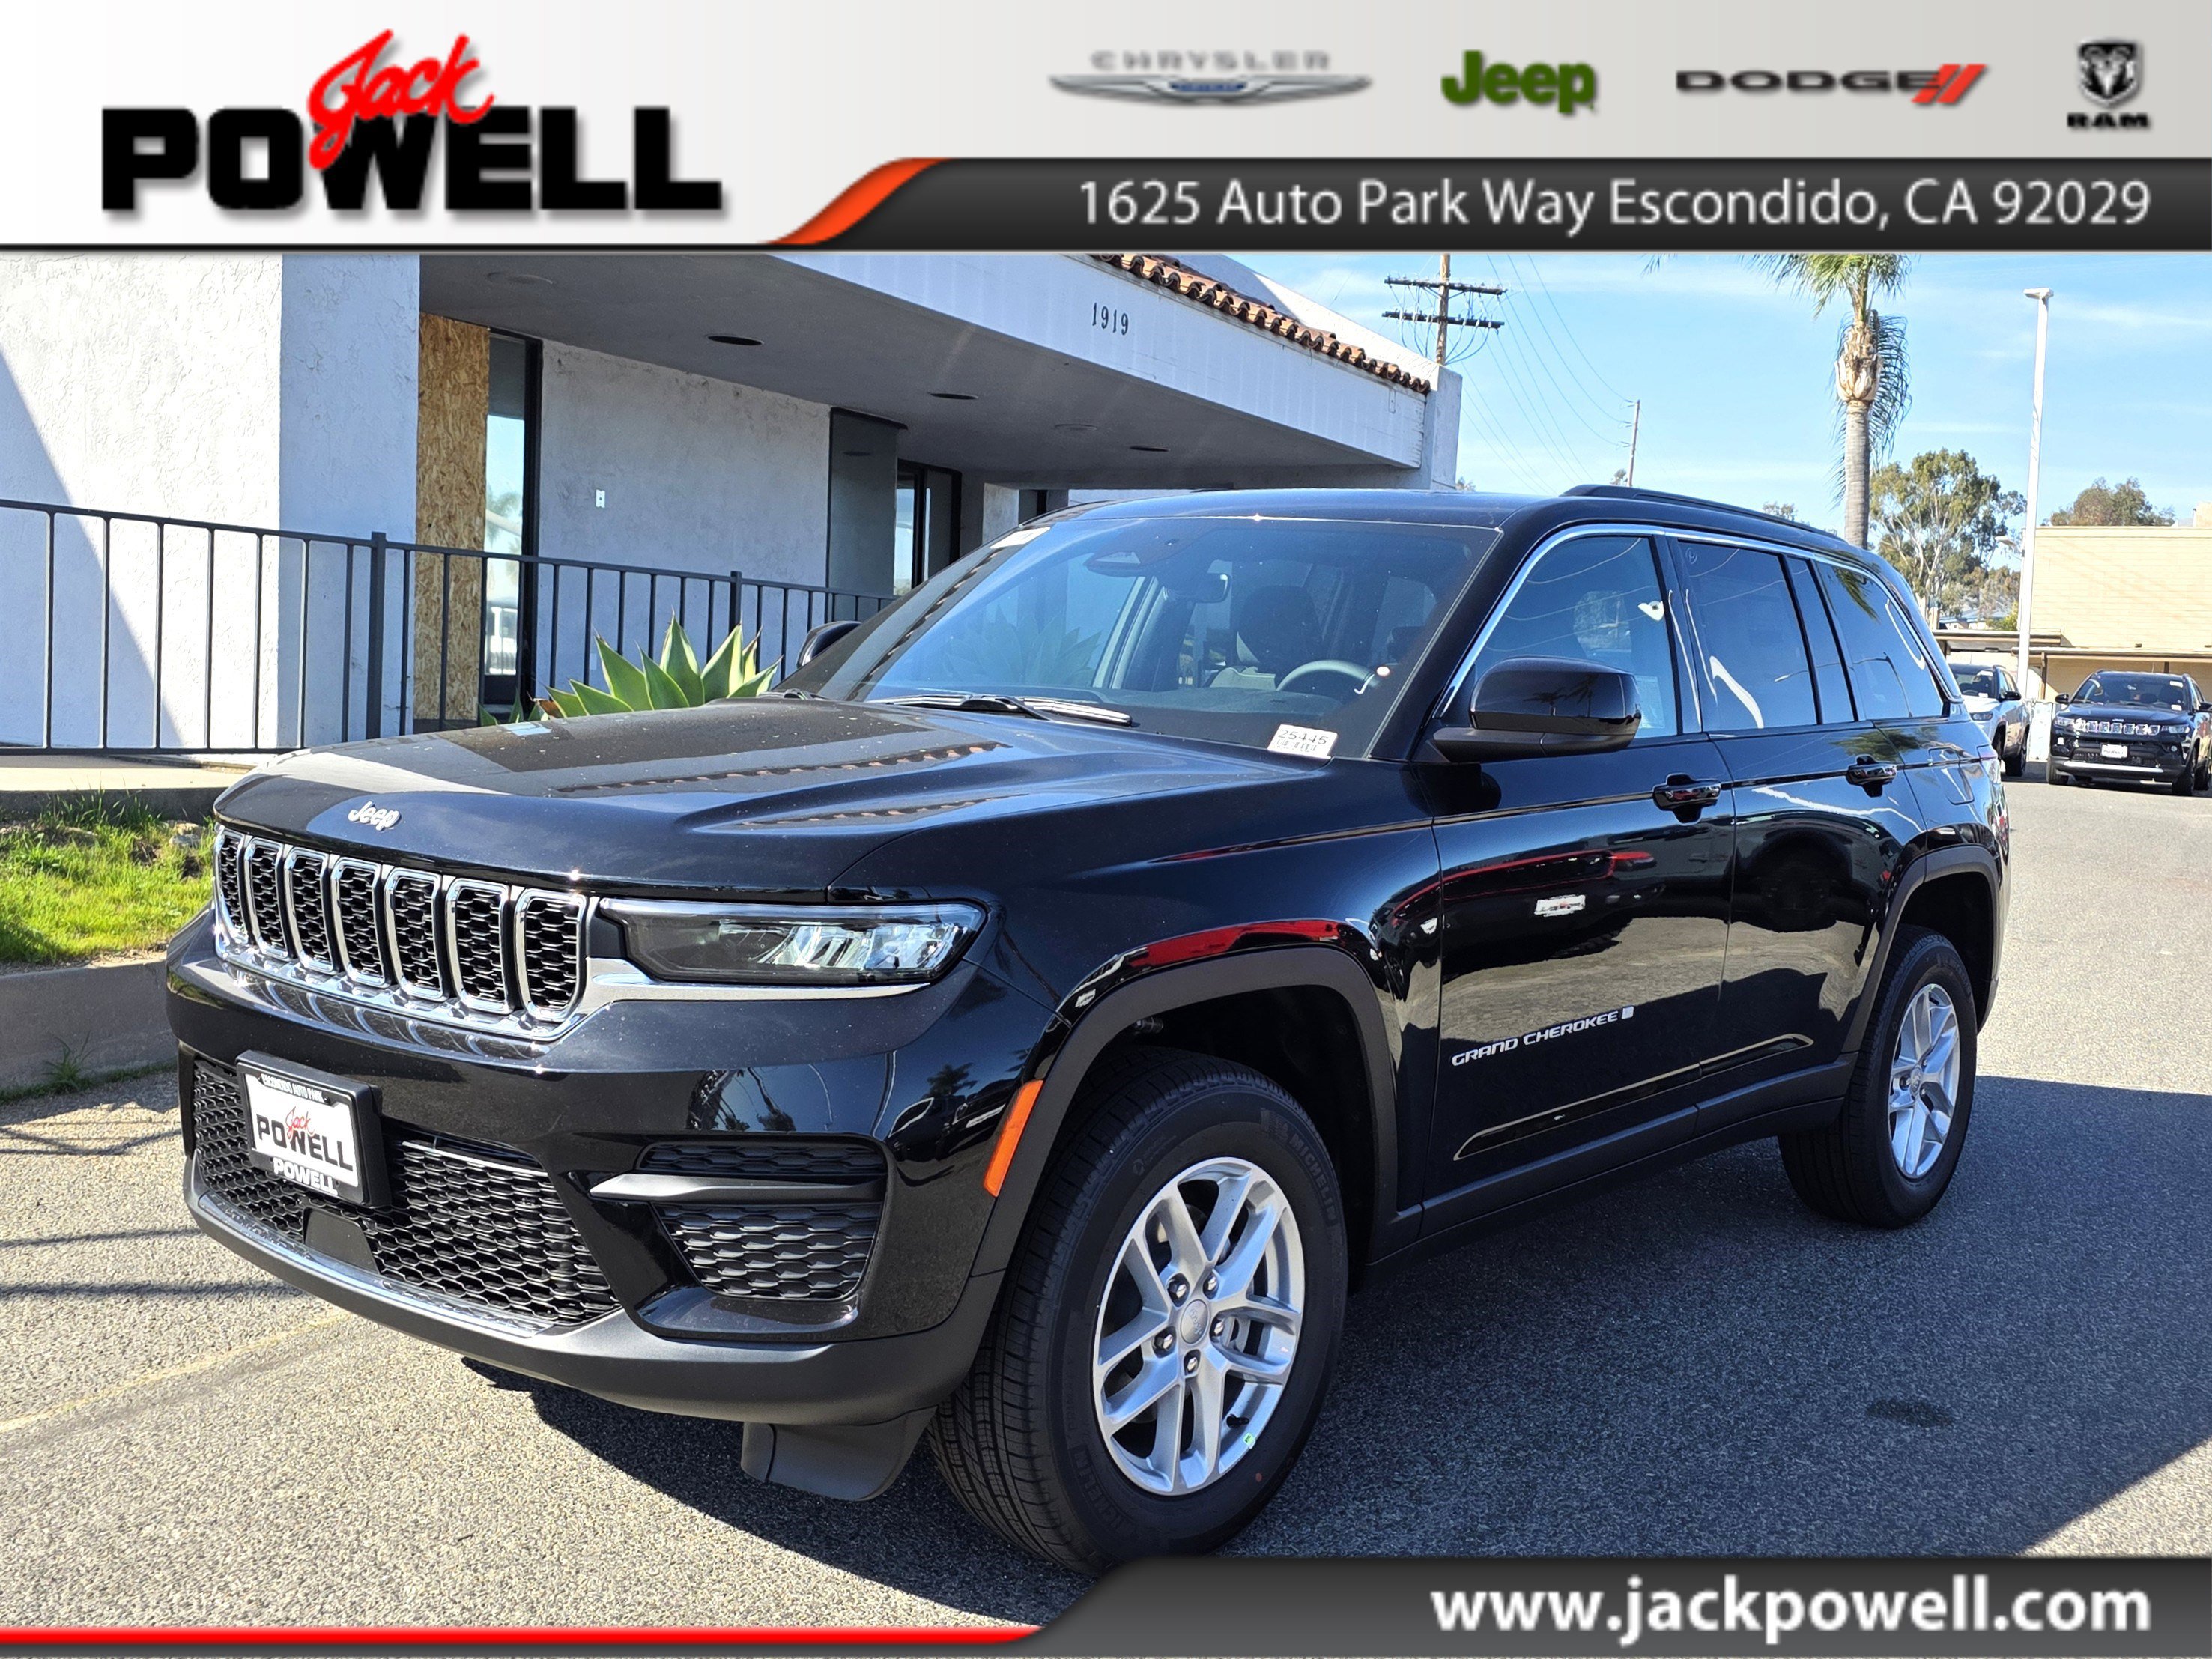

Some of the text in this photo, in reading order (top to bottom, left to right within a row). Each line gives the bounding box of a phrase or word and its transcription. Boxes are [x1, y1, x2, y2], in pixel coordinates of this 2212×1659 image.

[1091, 302, 1129, 336] 1919
[1279, 730, 1329, 744] 25445
[348, 801, 402, 831] Jeep
[1452, 1010, 1619, 1067] GRAND CHEROKEE
[285, 1106, 315, 1139] Jack
[256, 1113, 354, 1172] POWELL
[273, 1156, 339, 1197] POWELL
[1288, 1132, 1339, 1222] MICHELIN
